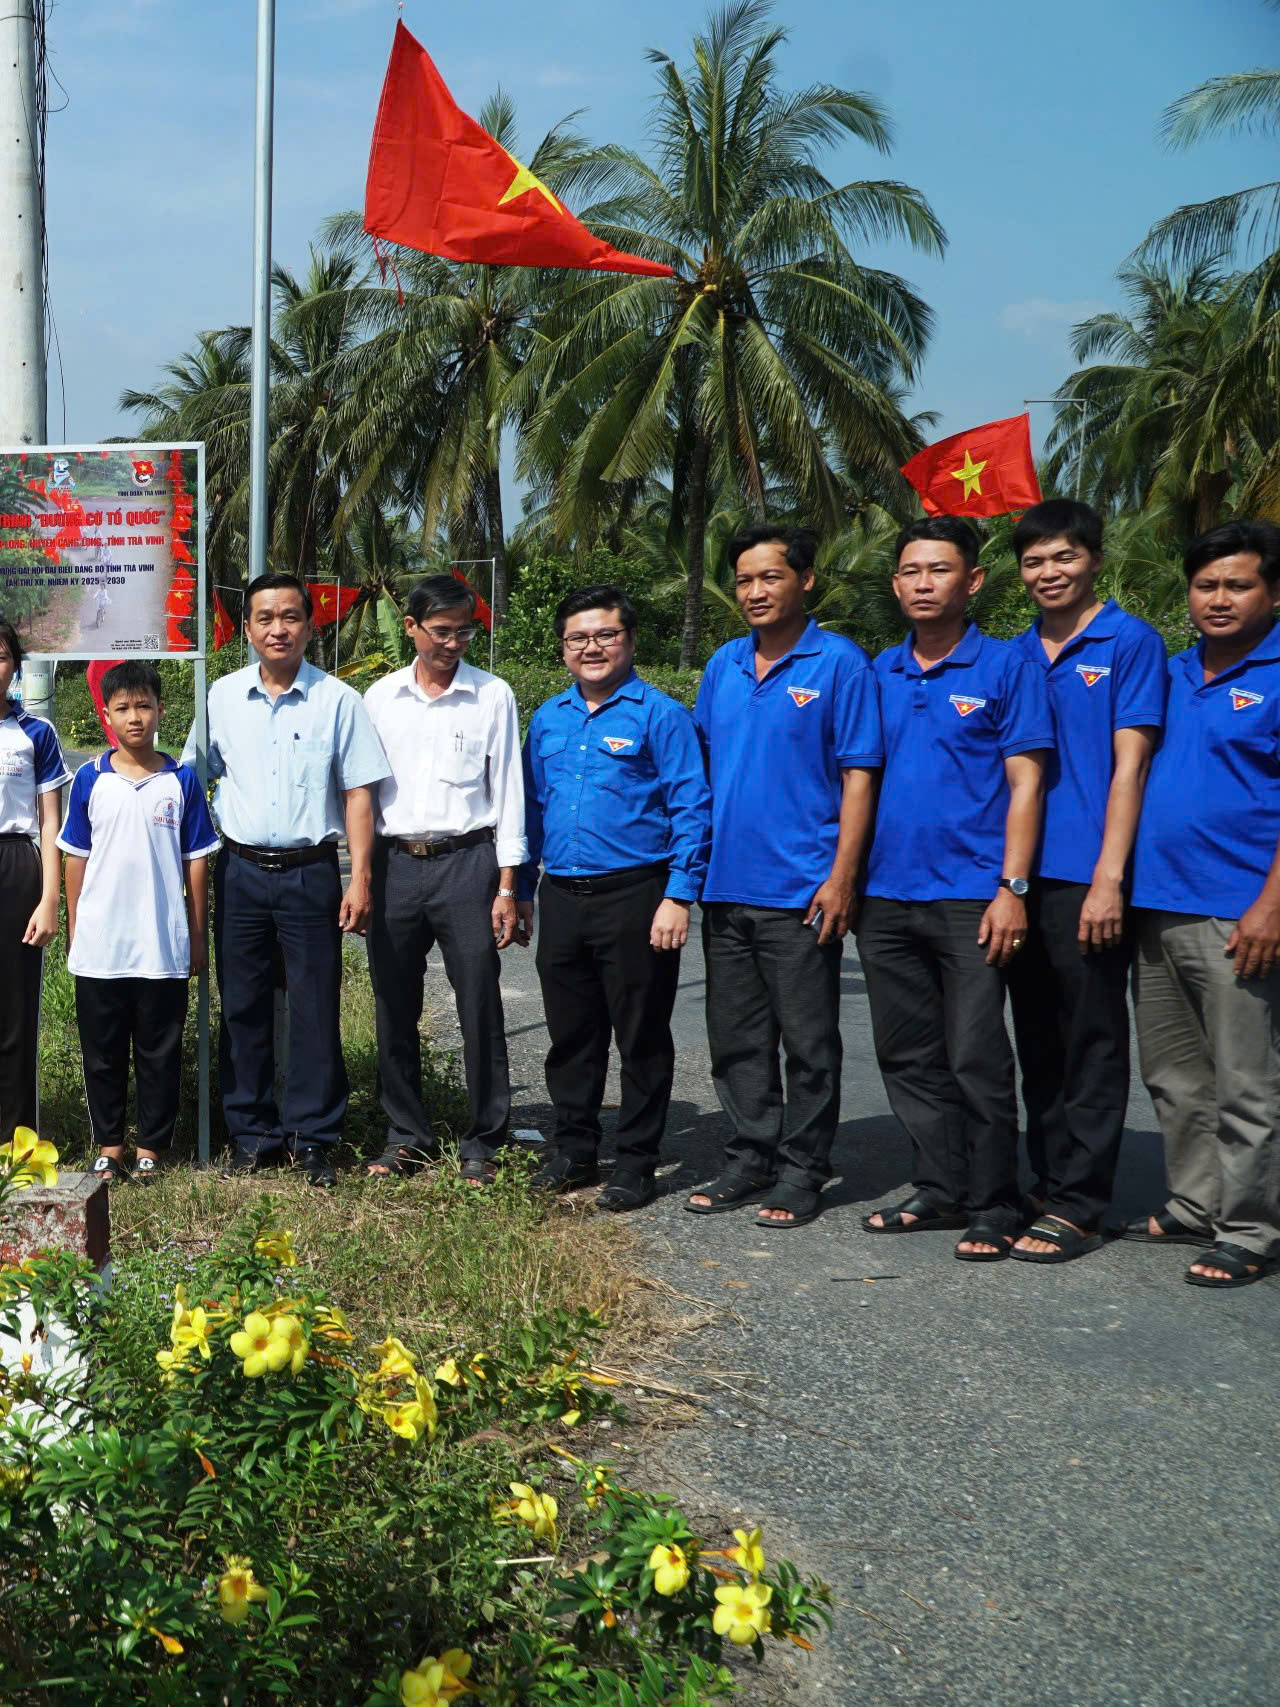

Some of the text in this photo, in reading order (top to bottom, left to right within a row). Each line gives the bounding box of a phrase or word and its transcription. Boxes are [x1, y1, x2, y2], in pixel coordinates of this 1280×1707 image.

[145, 535, 164, 546] VINH
[138, 564, 155, 572] VINH
[81, 576, 100, 586] 2025
[107, 576, 126, 585] 2030
